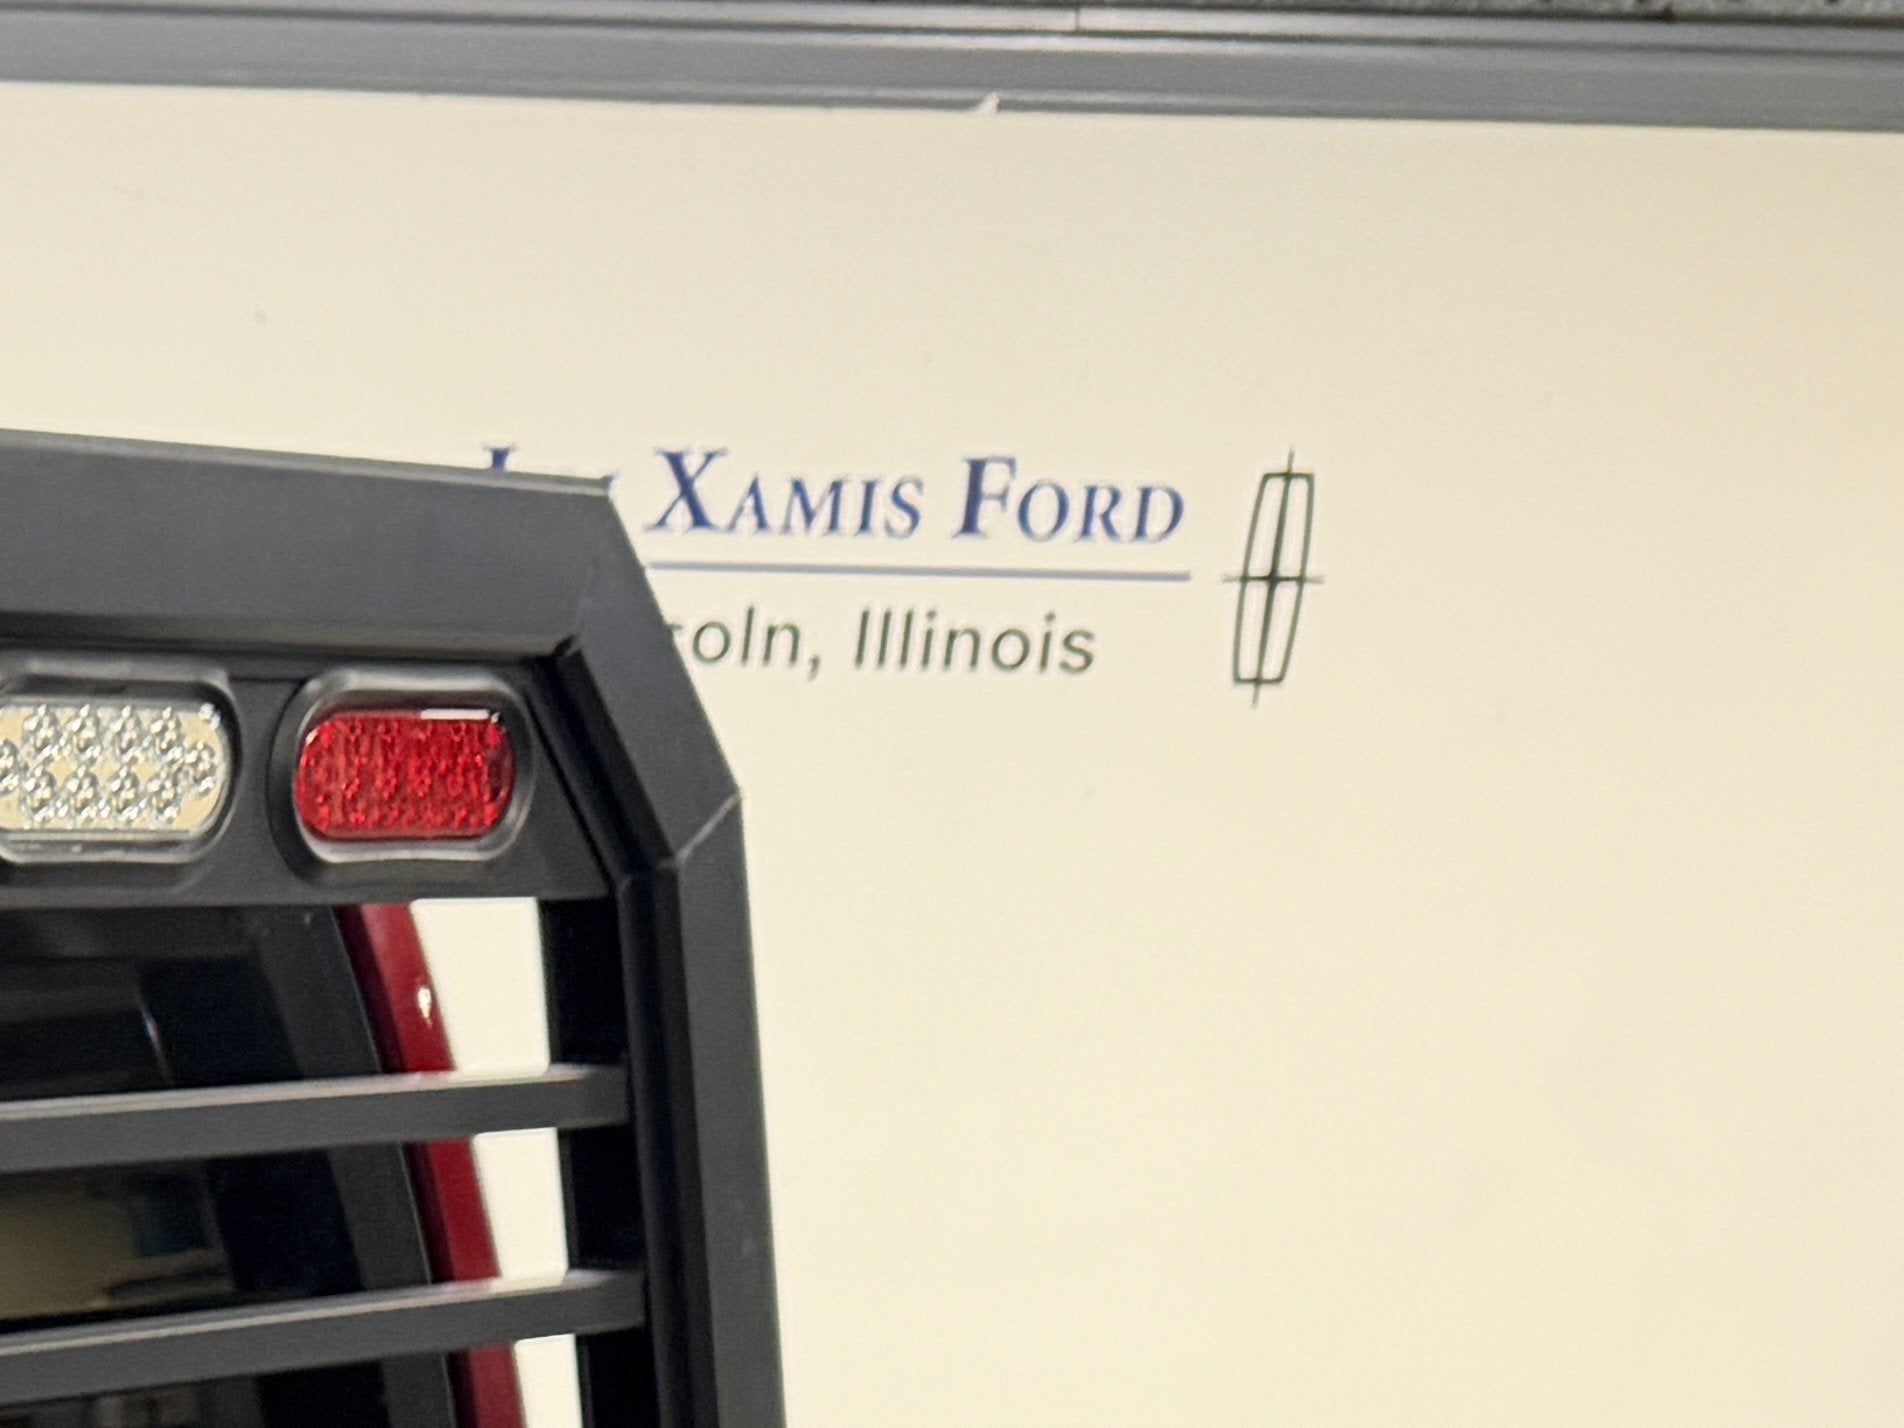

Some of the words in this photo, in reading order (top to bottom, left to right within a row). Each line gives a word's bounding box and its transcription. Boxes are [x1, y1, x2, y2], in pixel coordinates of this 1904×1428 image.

[644, 449, 924, 540] XAMIS
[951, 456, 1185, 543] FORD
[669, 604, 821, 682] oln,
[855, 607, 1096, 675] Illinois
